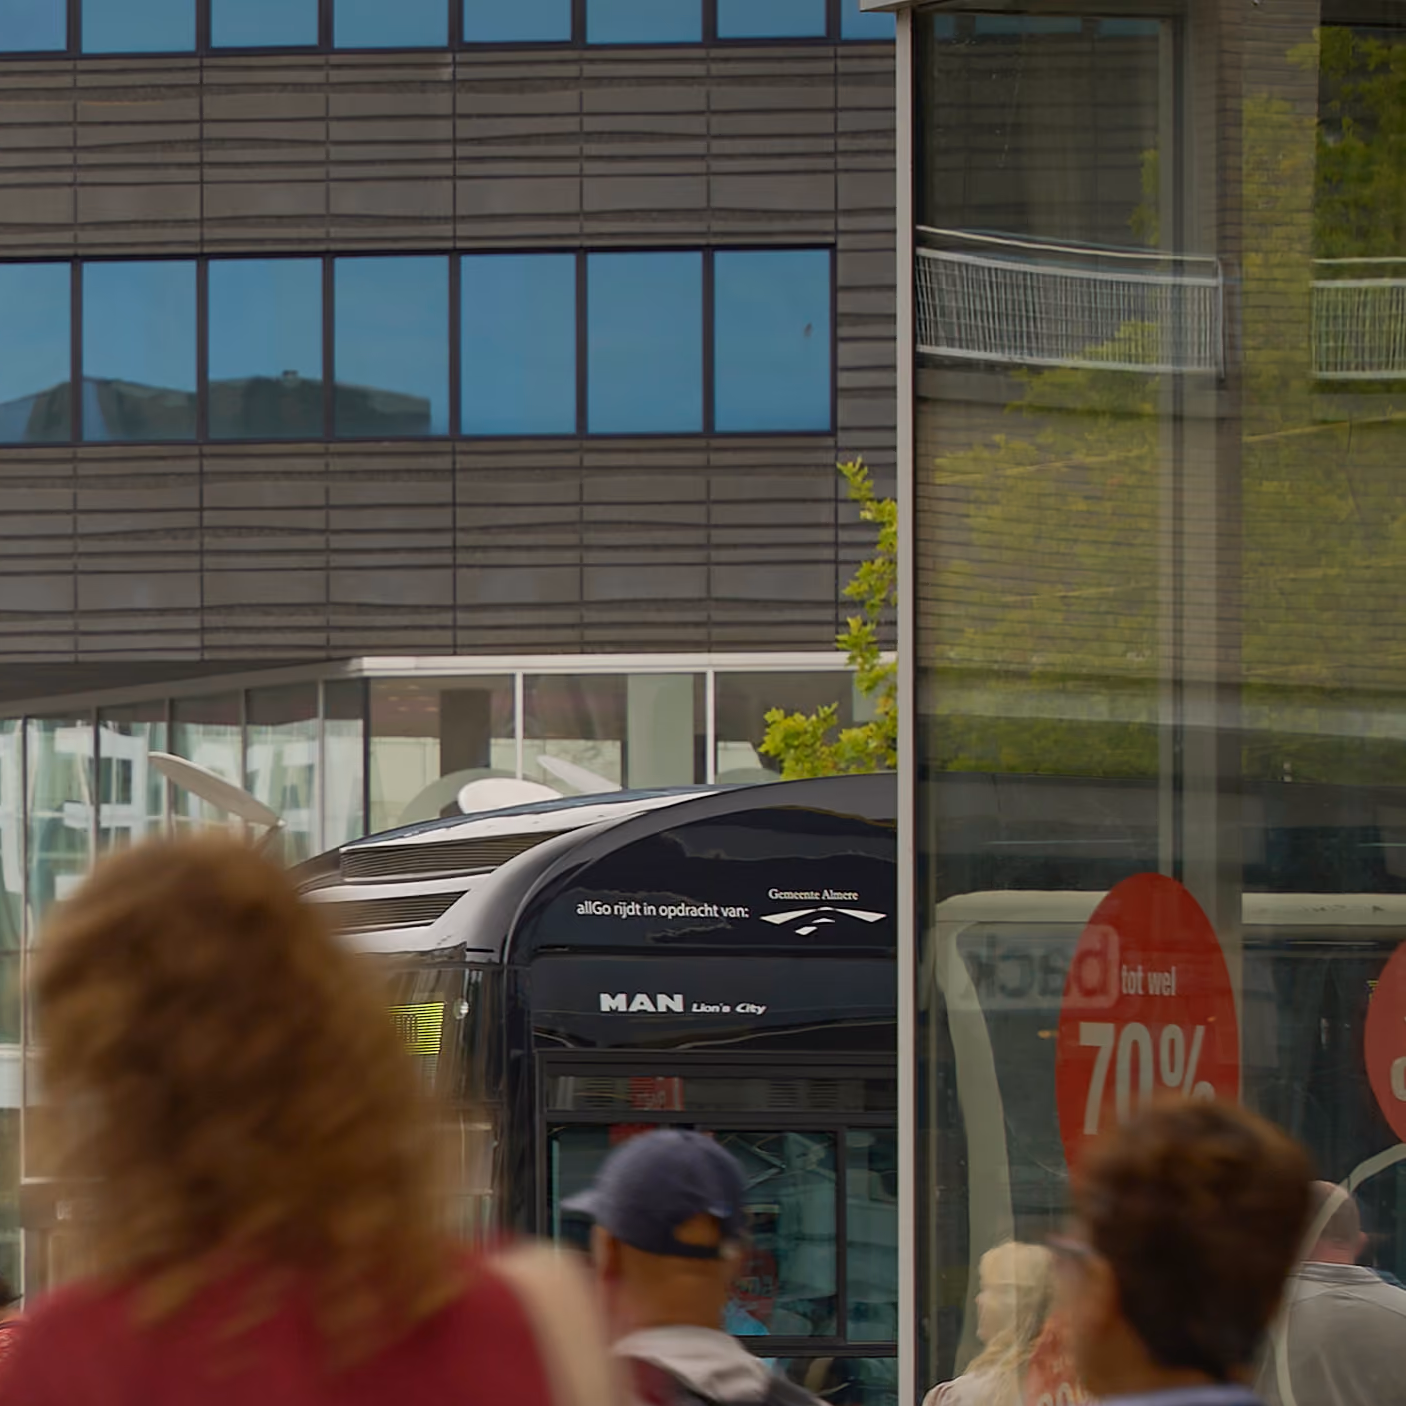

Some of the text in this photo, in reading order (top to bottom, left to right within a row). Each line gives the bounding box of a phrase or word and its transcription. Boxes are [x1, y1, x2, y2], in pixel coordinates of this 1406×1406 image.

[768, 888, 859, 900] Gemeente Almere
[576, 900, 749, 920] allGo rijdt in opdracht van:
[1122, 965, 1176, 996] tot wel
[600, 993, 767, 1015] MAN Lion's City
[1079, 1022, 1216, 1135] 70%
